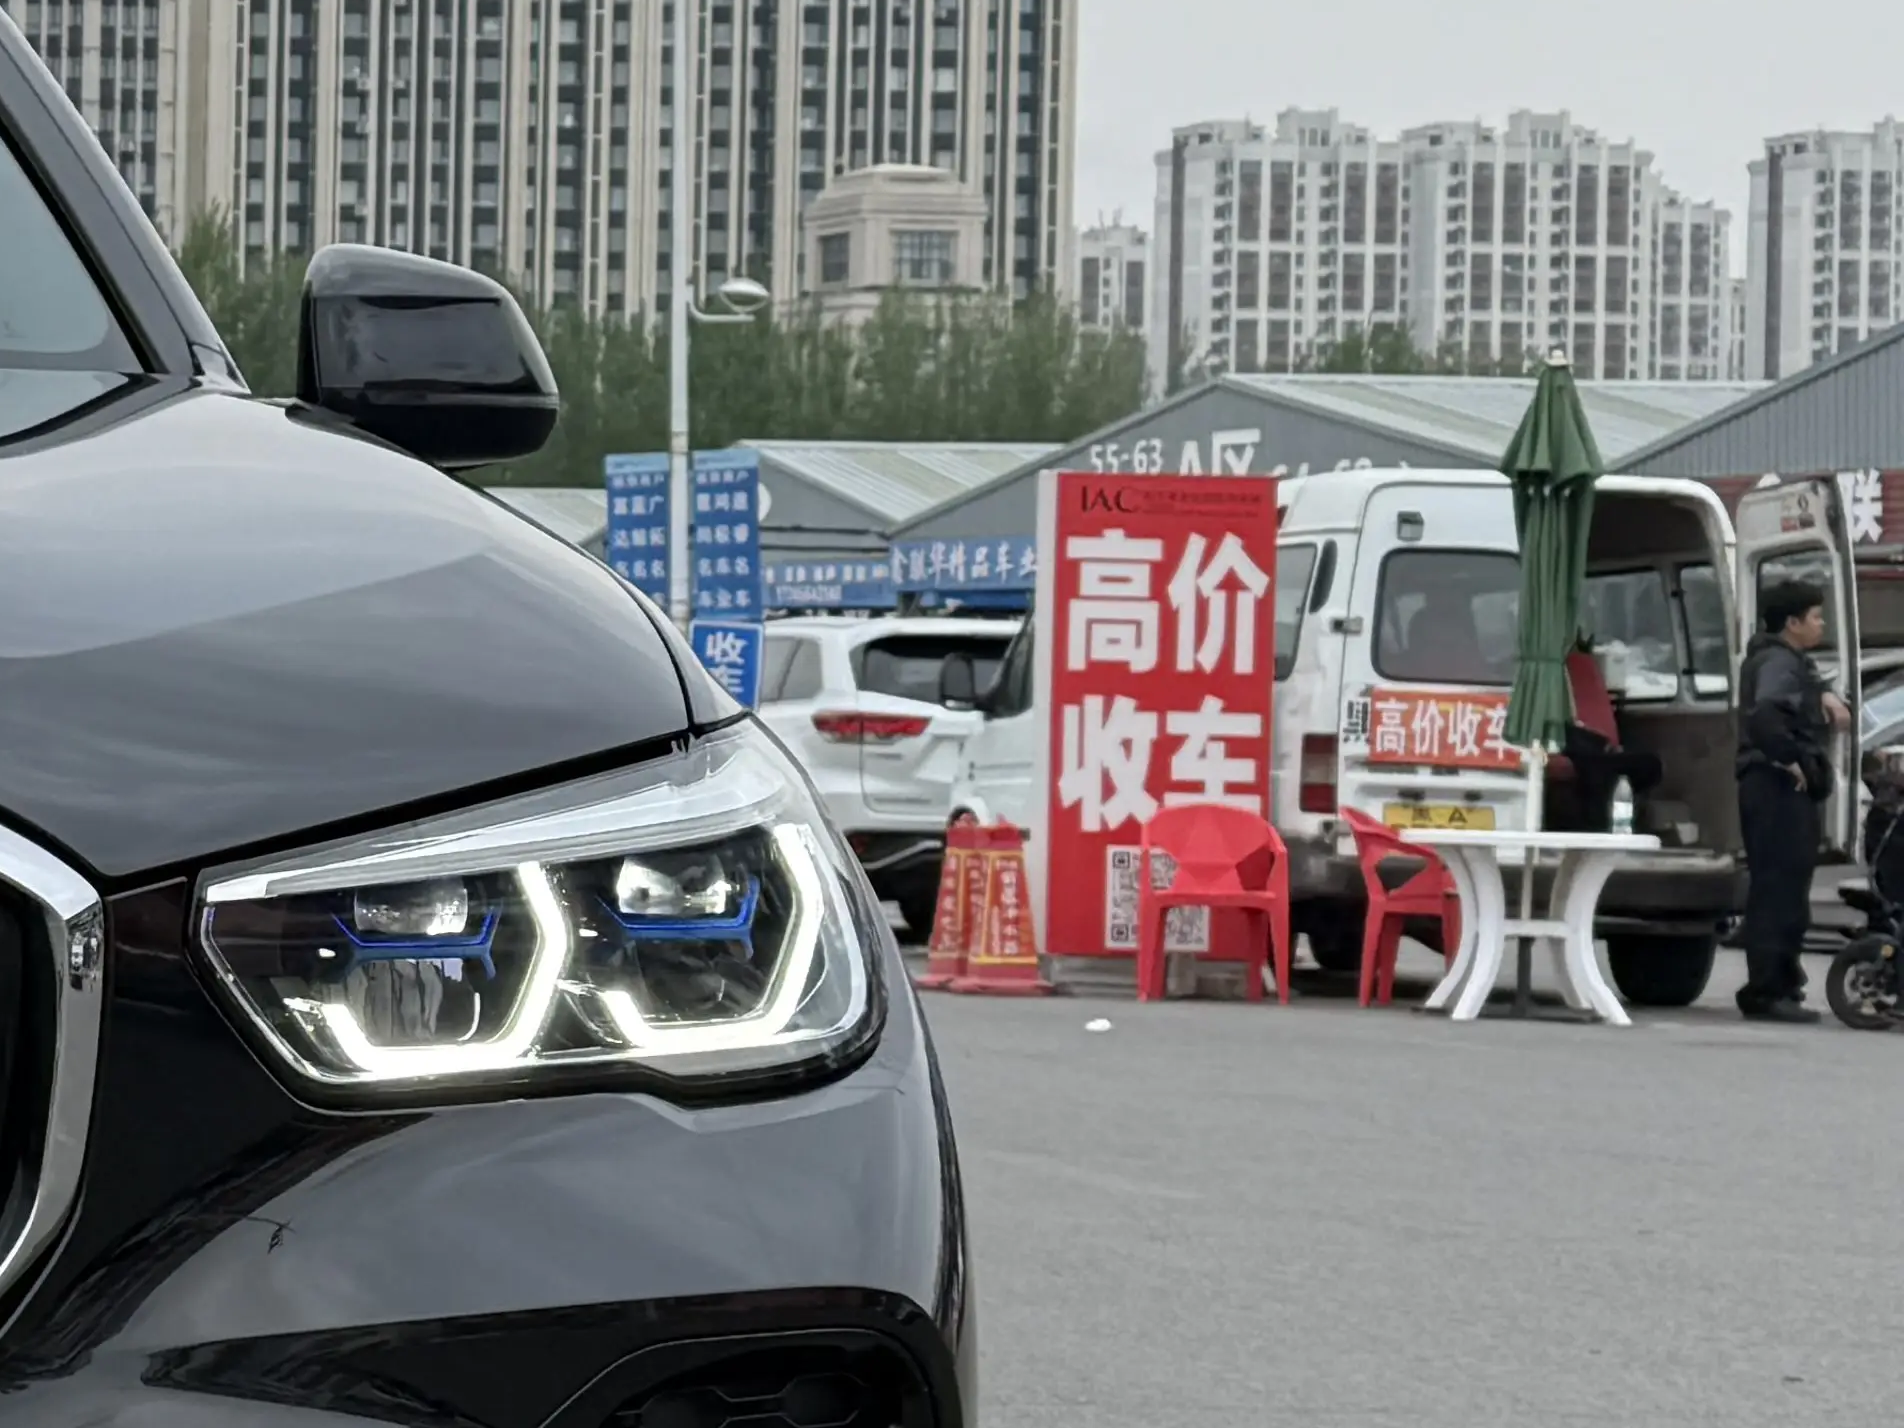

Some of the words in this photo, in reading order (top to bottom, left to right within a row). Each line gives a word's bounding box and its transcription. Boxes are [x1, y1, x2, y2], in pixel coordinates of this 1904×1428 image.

[1091, 438, 1164, 477] 55-63
[1080, 484, 1139, 513] IAC
[1066, 527, 1270, 675] 高价
[1375, 697, 1510, 761] 高价收车
[1058, 693, 1262, 832] 收车
